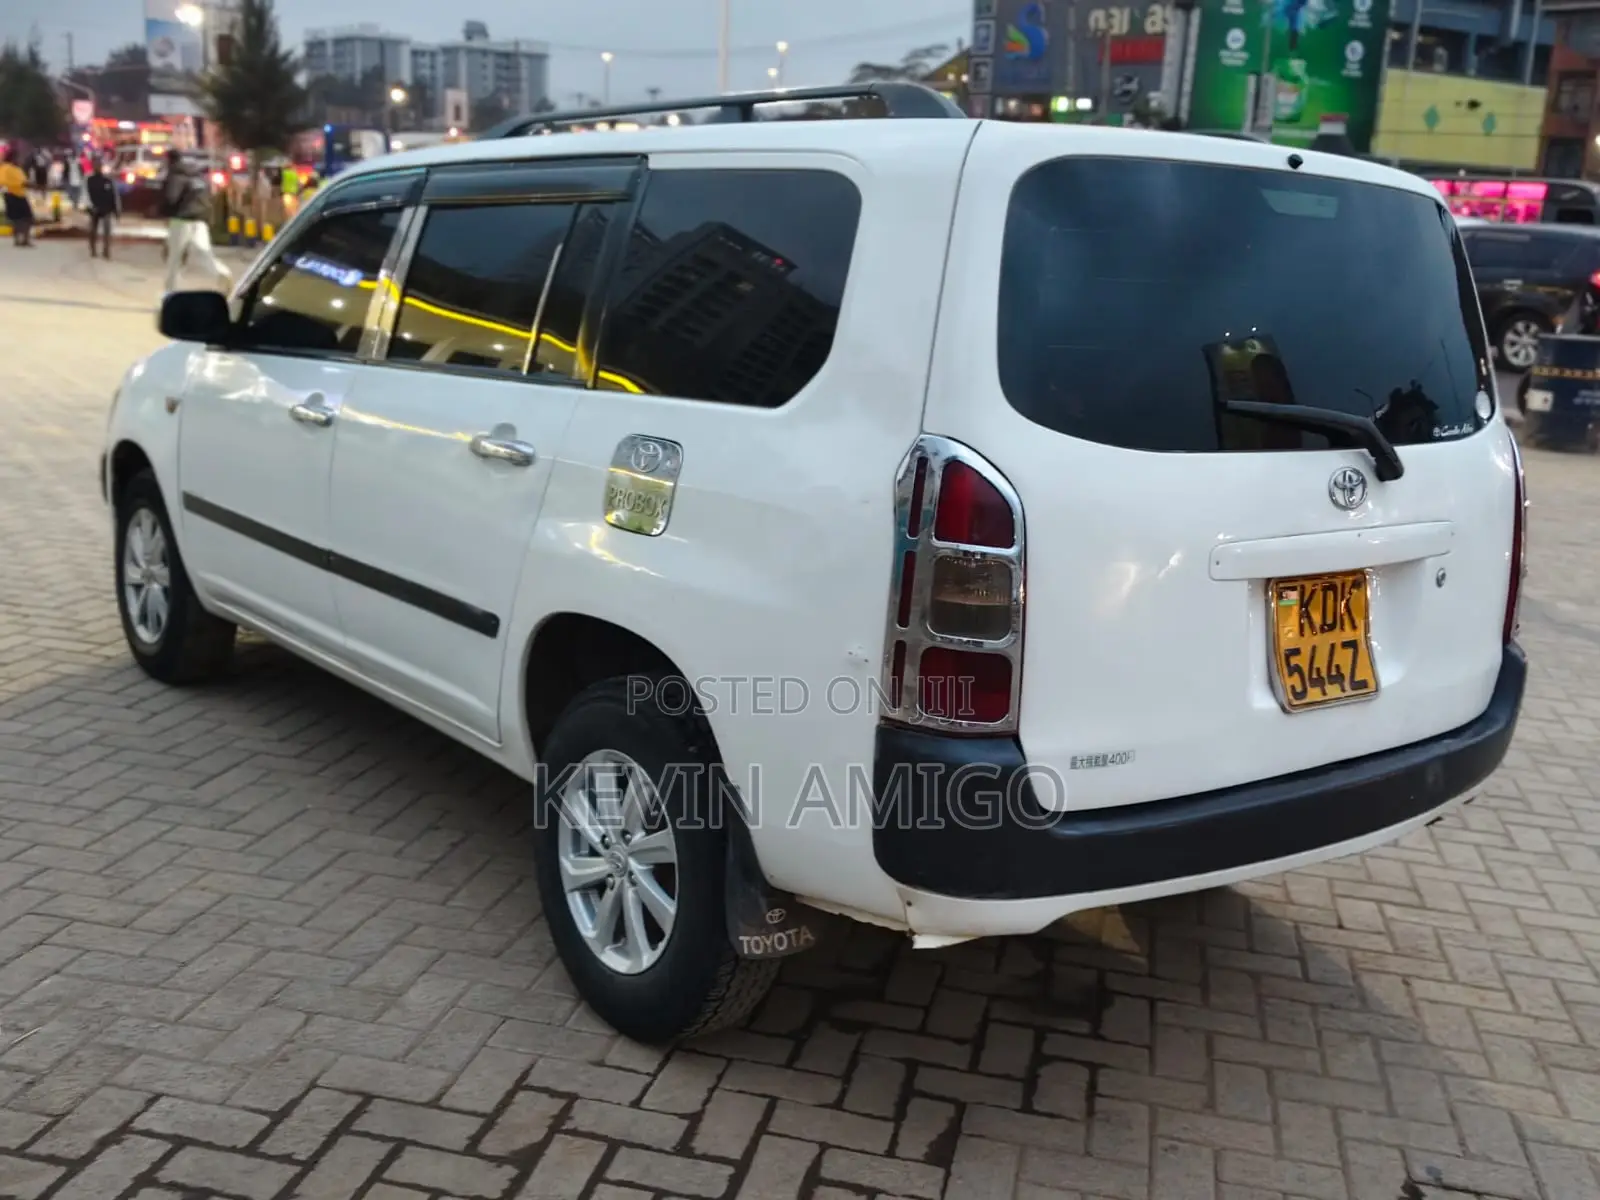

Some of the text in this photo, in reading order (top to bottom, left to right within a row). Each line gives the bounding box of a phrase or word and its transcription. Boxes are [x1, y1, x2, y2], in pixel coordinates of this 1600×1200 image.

[1299, 580, 1362, 637] KDK
[1284, 639, 1368, 700] 544Z
[738, 925, 816, 954] TOYOTA
